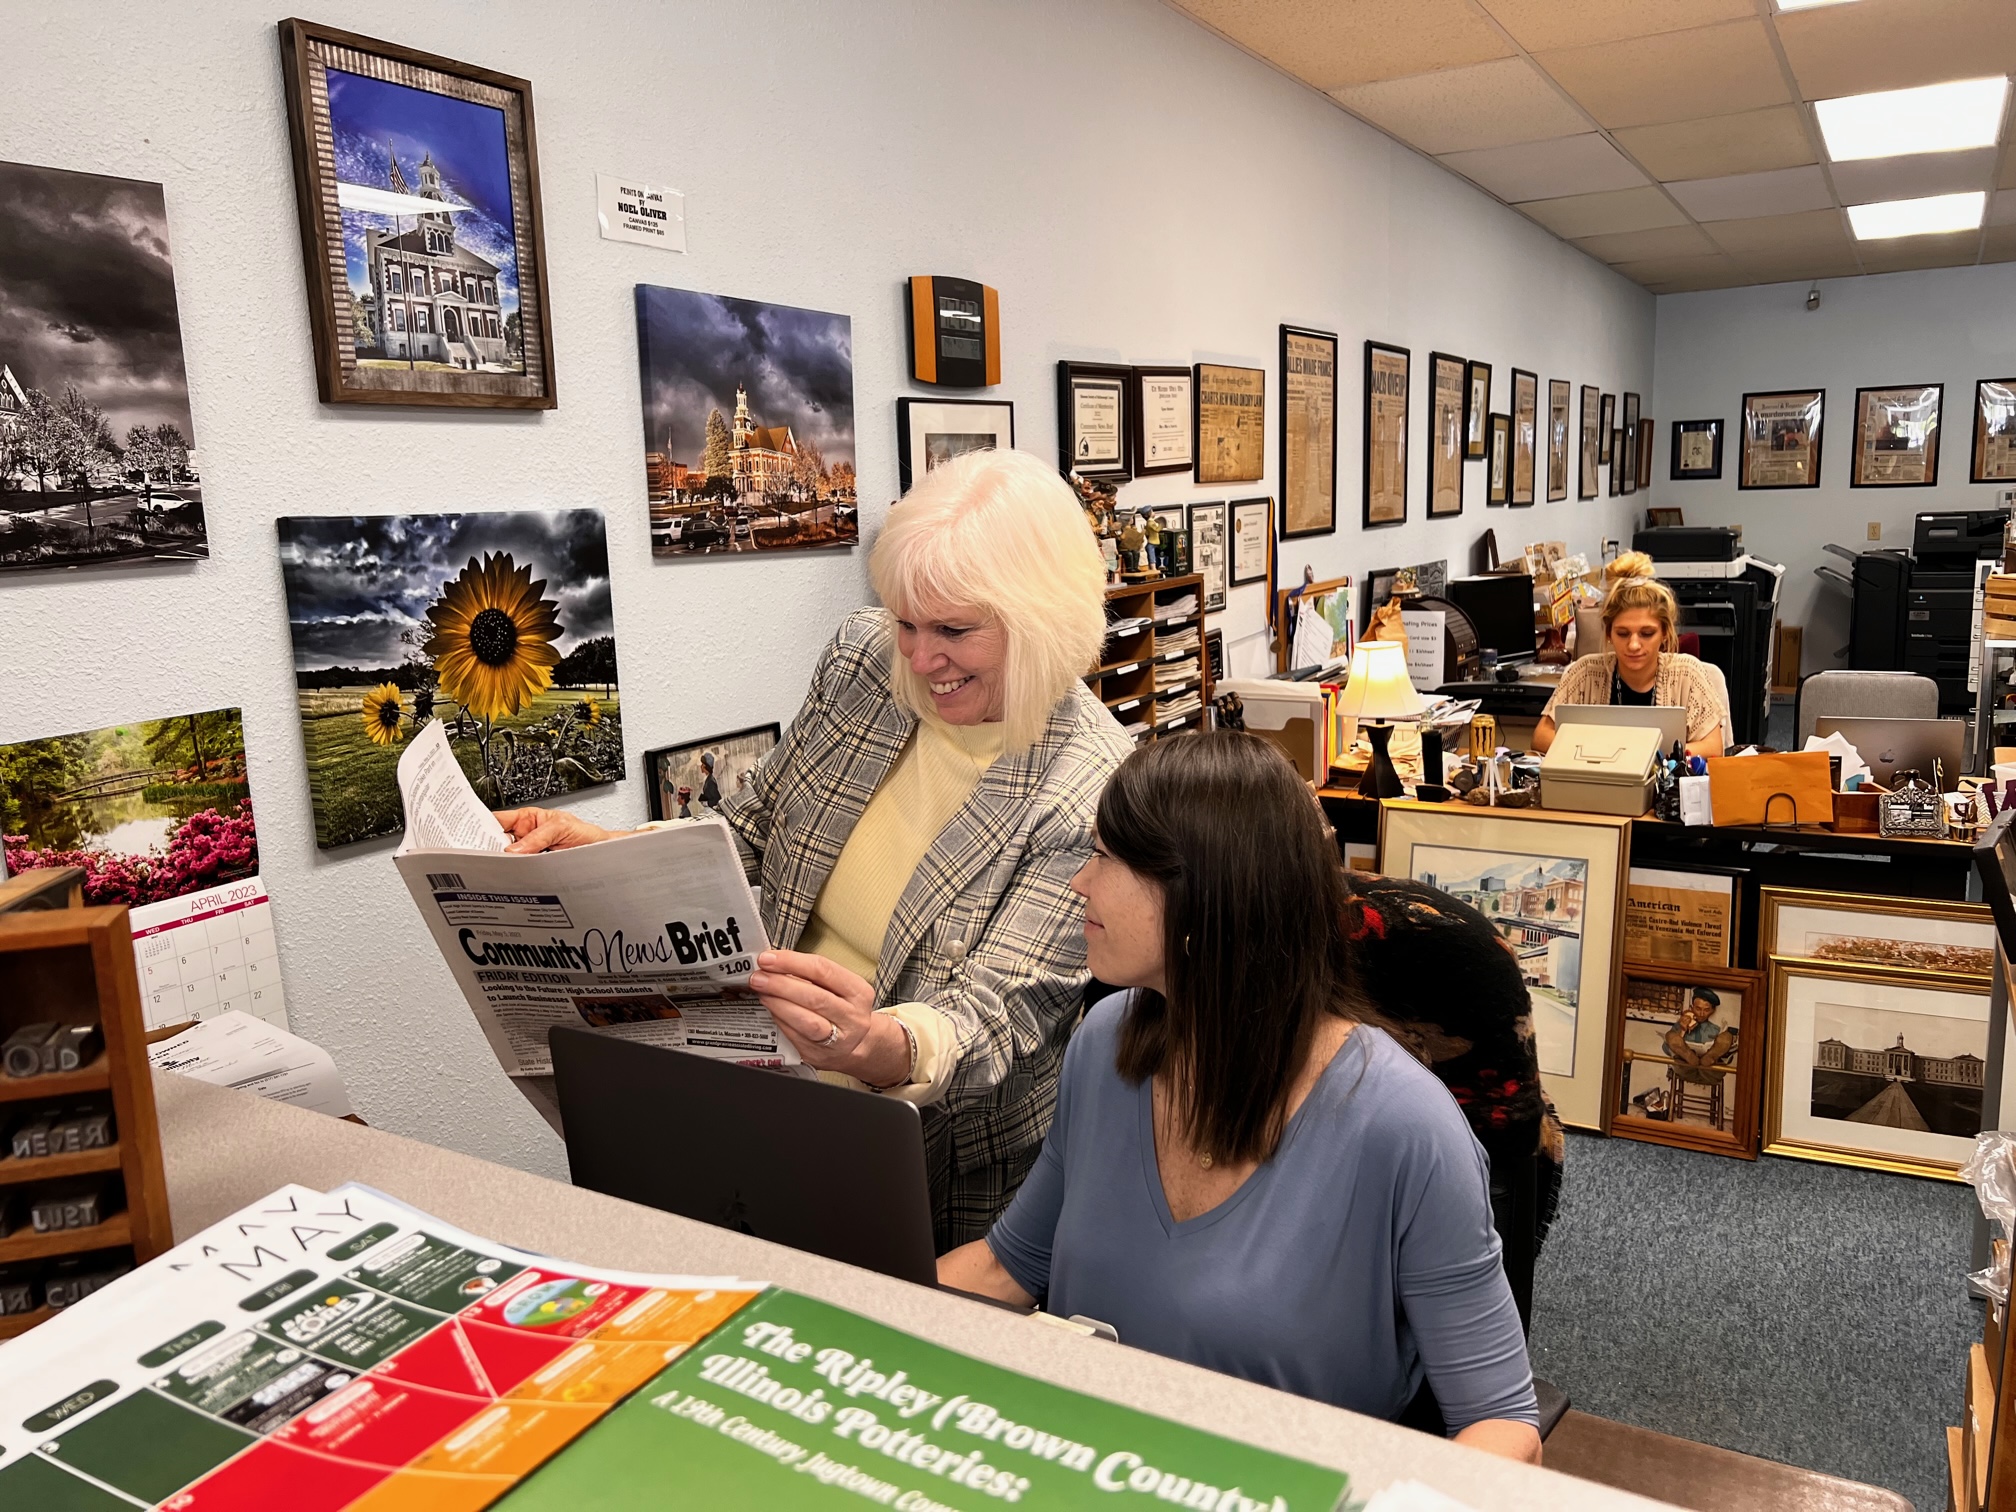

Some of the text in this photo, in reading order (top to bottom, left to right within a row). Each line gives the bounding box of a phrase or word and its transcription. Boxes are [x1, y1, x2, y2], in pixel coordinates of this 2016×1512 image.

[620, 187, 637, 197] PRINTS
[618, 202, 667, 220] NOEL OLIVER
[623, 223, 642, 231] FRAMED
[629, 217, 647, 225] CANVAS
[1371, 370, 1386, 395] NAZIS
[190, 885, 257, 912] APRIL 2023
[457, 893, 540, 904] INSIDE THIS ISSUE
[1627, 898, 1681, 912] American
[145, 926, 160, 935] WED
[181, 917, 193, 925] THU
[244, 900, 255, 908] SAT
[1681, 920, 1702, 928] Violence
[1704, 922, 1722, 930] Threat
[1655, 925, 1683, 934] Venezuela
[1697, 929, 1722, 938] Enforced
[458, 916, 743, 974] Community News Brief
[147, 967, 153, 975] 5
[718, 959, 751, 975] $1.00
[153, 964, 257, 1003] 12 13 14 15
[476, 971, 572, 984] FRIDAY EDITION
[481, 983, 515, 993] Looking
[523, 984, 536, 992] the
[537, 986, 565, 994] Future:
[565, 987, 585, 996] High
[585, 986, 614, 994] School
[615, 986, 653, 994] Students
[191, 1011, 201, 1021] 20
[223, 1002, 231, 1010] 21
[254, 991, 262, 1000] 22
[497, 994, 526, 1002] Launch
[526, 995, 570, 1003] Businesses
[219, 1198, 364, 1281] MAY
[350, 1234, 378, 1251] SAT
[265, 1282, 294, 1299] FRI
[281, 1303, 327, 1331] BALL
[162, 1332, 201, 1354] THU
[741, 1320, 813, 1363] The
[812, 1347, 943, 1418] Ripley
[930, 1393, 1097, 1472] (Brown
[46, 1391, 95, 1420] WED
[697, 1353, 1032, 1503] Illinois Potteries:
[650, 1389, 680, 1409] A
[669, 1393, 727, 1428] 19th
[718, 1414, 810, 1466] Century
[793, 1450, 902, 1506] Jugtown
